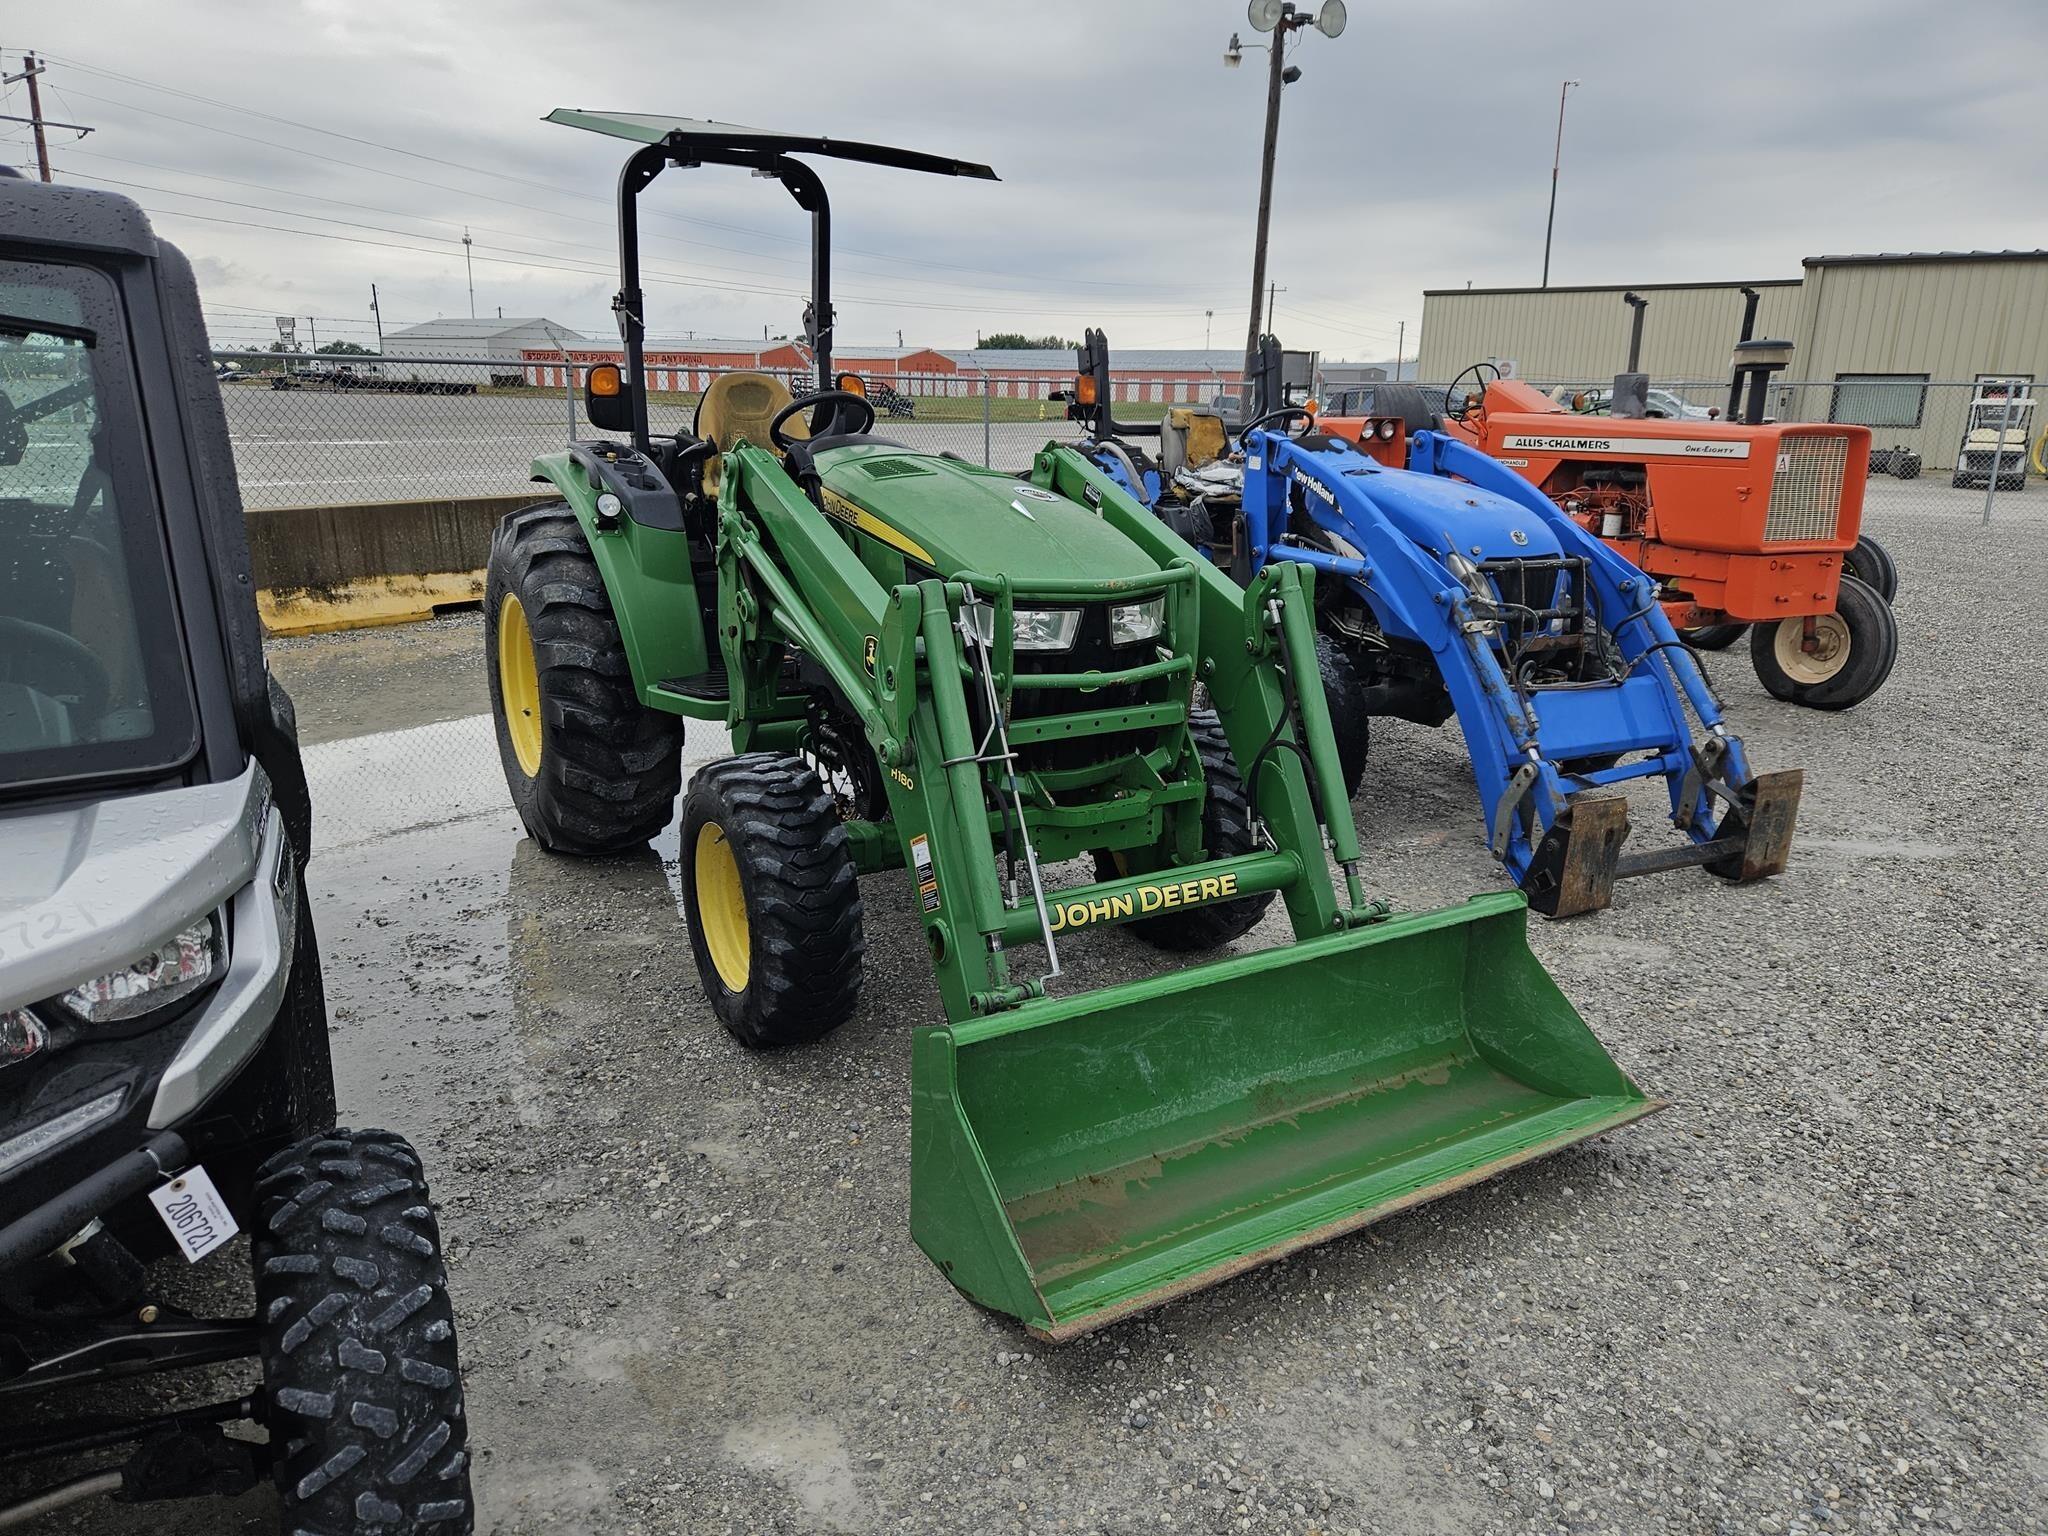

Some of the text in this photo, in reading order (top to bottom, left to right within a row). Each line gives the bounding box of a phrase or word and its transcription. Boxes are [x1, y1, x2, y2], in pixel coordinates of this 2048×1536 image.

[1515, 438, 1610, 449] ALLIS-CHALMERS
[835, 499, 858, 526] DEERE
[890, 768, 914, 791] H180
[1050, 872, 1238, 932] JOHN DEERE
[165, 1194, 218, 1254] 206721
